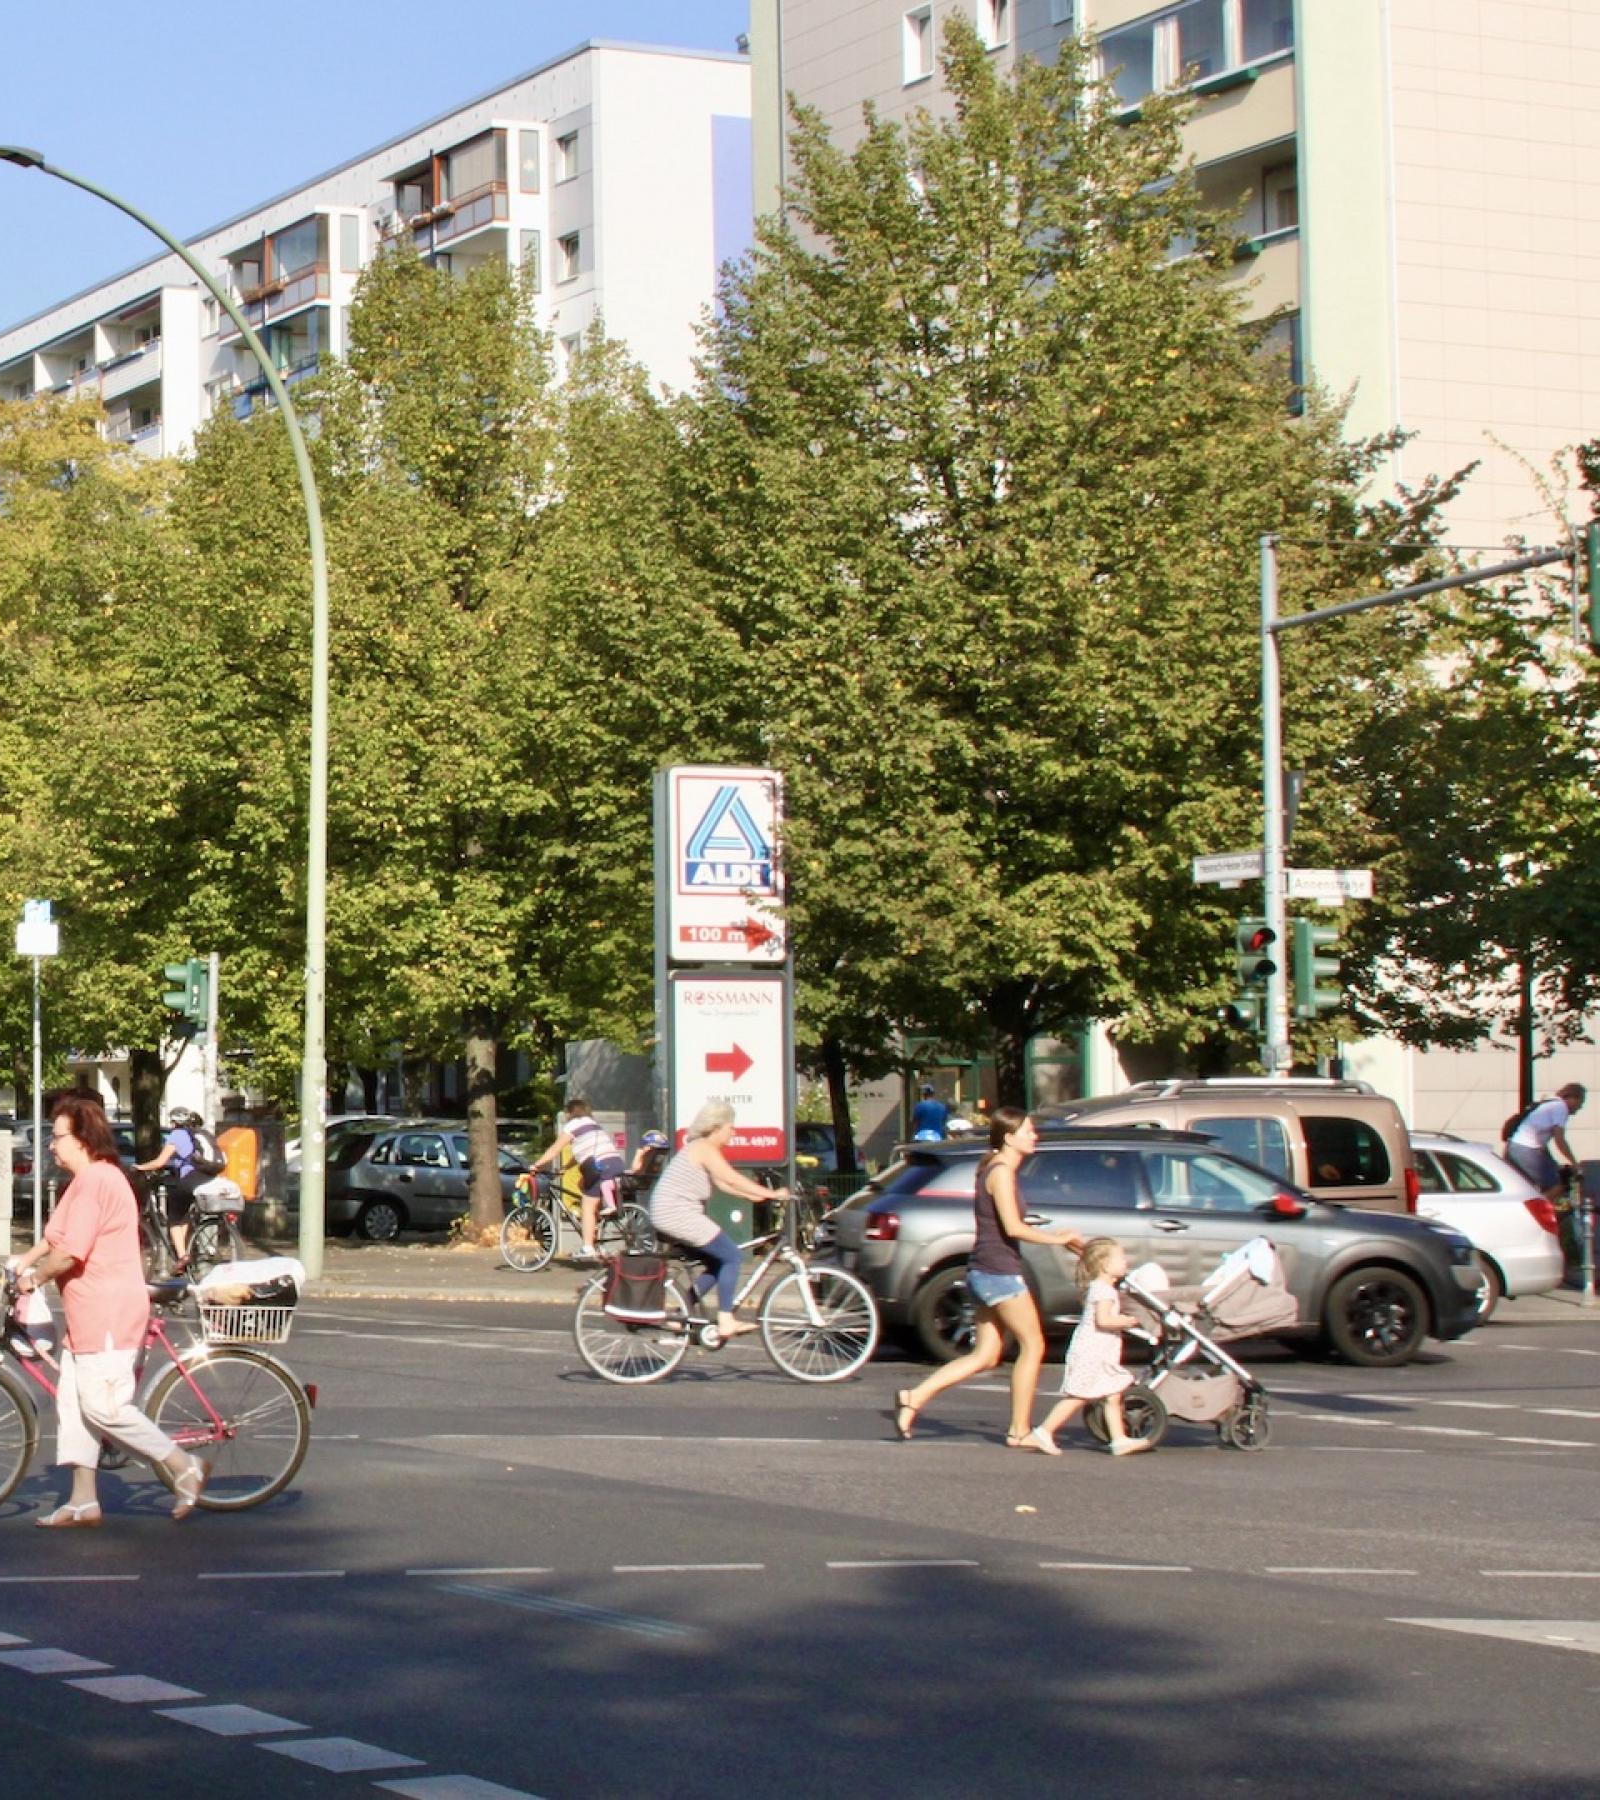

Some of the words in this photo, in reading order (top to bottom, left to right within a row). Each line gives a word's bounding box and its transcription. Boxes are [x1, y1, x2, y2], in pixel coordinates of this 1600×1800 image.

[692, 863, 761, 885] ALDI
[688, 927, 721, 941] 100
[727, 930, 746, 942] m
[683, 991, 773, 1005] ROSSMANN
[724, 1094, 753, 1104] METER
